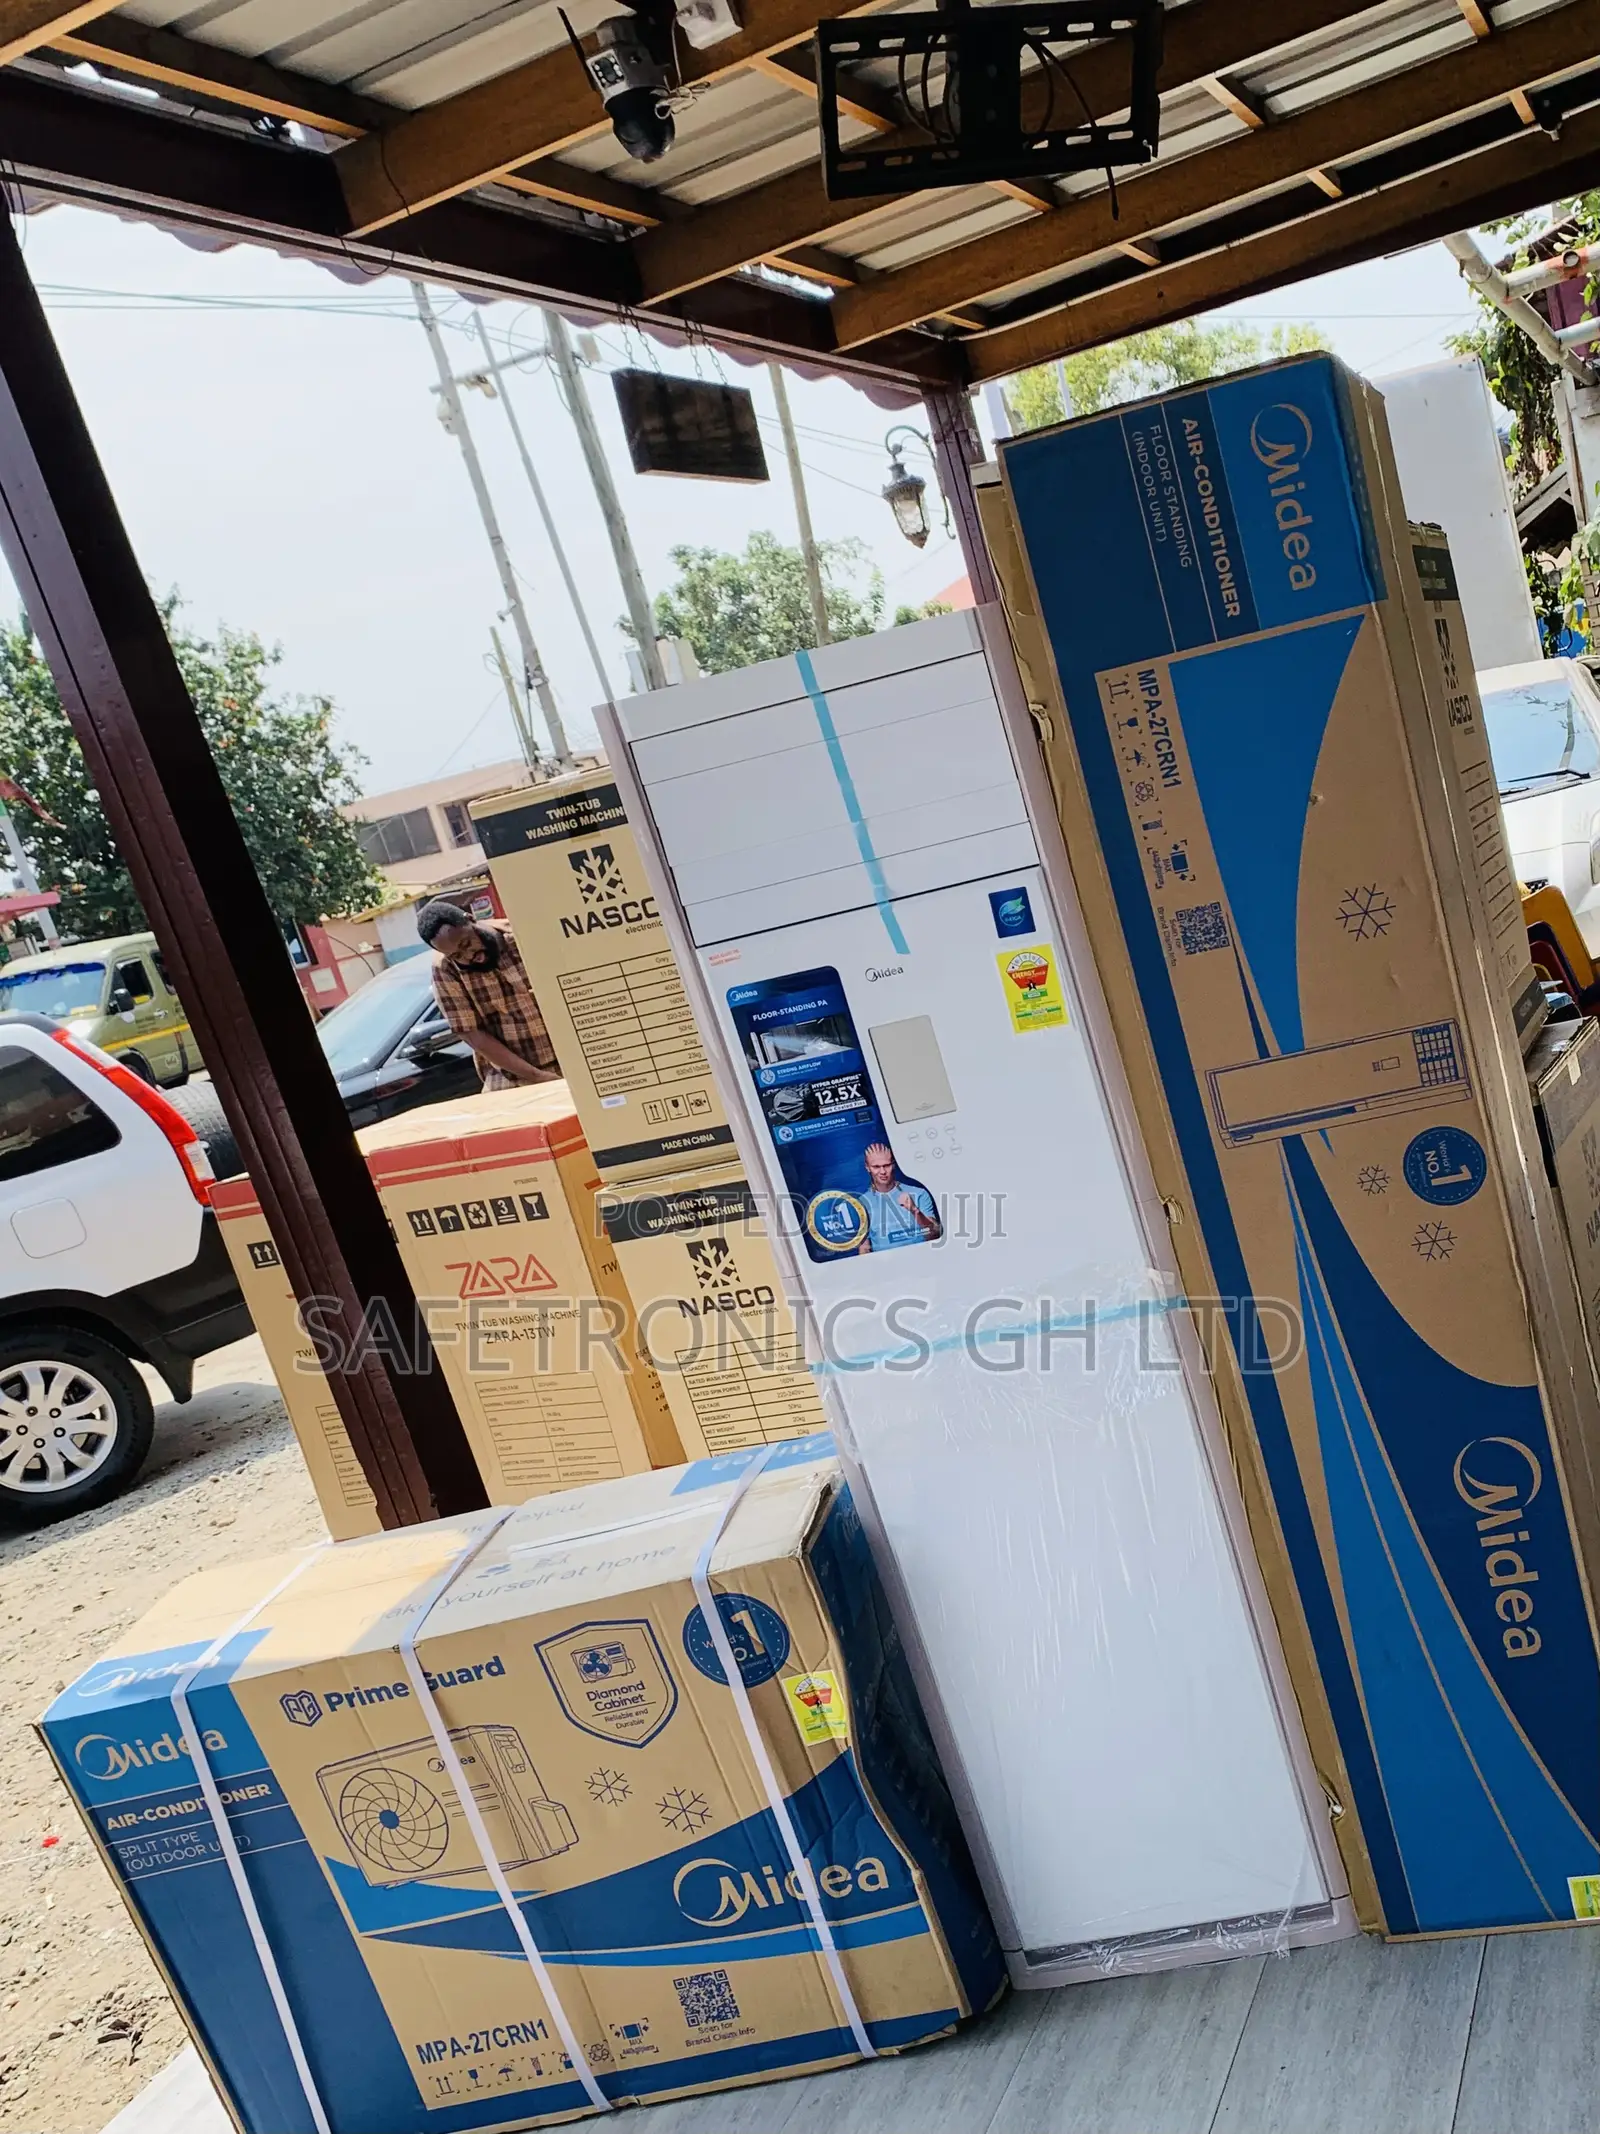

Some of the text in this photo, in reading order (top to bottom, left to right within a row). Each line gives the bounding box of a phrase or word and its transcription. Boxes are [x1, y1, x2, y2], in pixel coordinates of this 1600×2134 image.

[1132, 431, 1168, 543] (INDOOR UNIT)
[1149, 424, 1192, 568] FLOOR STANDING
[1250, 403, 1317, 591] Midea
[1182, 417, 1241, 618] AIR-CONDITIONER
[1137, 668, 1182, 788] MPA-27CRN1
[546, 798, 601, 820] TWIN-TUB
[525, 806, 625, 840] WASHING MACHIN
[625, 920, 664, 934] electronic
[1157, 906, 1168, 930] Brand
[865, 966, 904, 982] Midea
[730, 990, 758, 1001] Midea
[752, 999, 828, 1022] FLOOR-STANDING PA
[661, 1133, 715, 1151] MADE IN CHINA
[647, 1202, 745, 1229] WASHING MACHINE
[667, 1195, 718, 1214] TWIN-TUB
[444, 1253, 558, 1299] ZARA
[601, 1260, 619, 1276] TW
[677, 1285, 776, 1319] NASCO
[739, 1306, 779, 1319] electronics
[455, 1309, 582, 1331] TWIN TUB WASHING MACHINE
[484, 1326, 556, 1344] ZARA-13TW
[296, 1349, 316, 1358] TWI
[1453, 1436, 1542, 1659] Midea
[440, 1572, 555, 1609] yourself
[560, 1566, 589, 1580] at
[596, 1546, 676, 1572] home
[730, 1609, 766, 1656] 1
[323, 1681, 410, 1712] Prime
[586, 1681, 646, 1701] Diamond
[594, 1693, 646, 1712] Cabinet
[604, 1708, 649, 1722] Reliable and
[615, 1718, 645, 1729] Durable
[107, 1783, 272, 1831] AIR-CONDIONER
[118, 1831, 200, 1859] SPLIT TYPE
[126, 1835, 251, 1873] (OUTDOOR UT)
[685, 2027, 756, 2048] Brand Claim Info
[698, 2021, 734, 2034] Scan for
[415, 2018, 549, 2065] MPA-27CRN1
